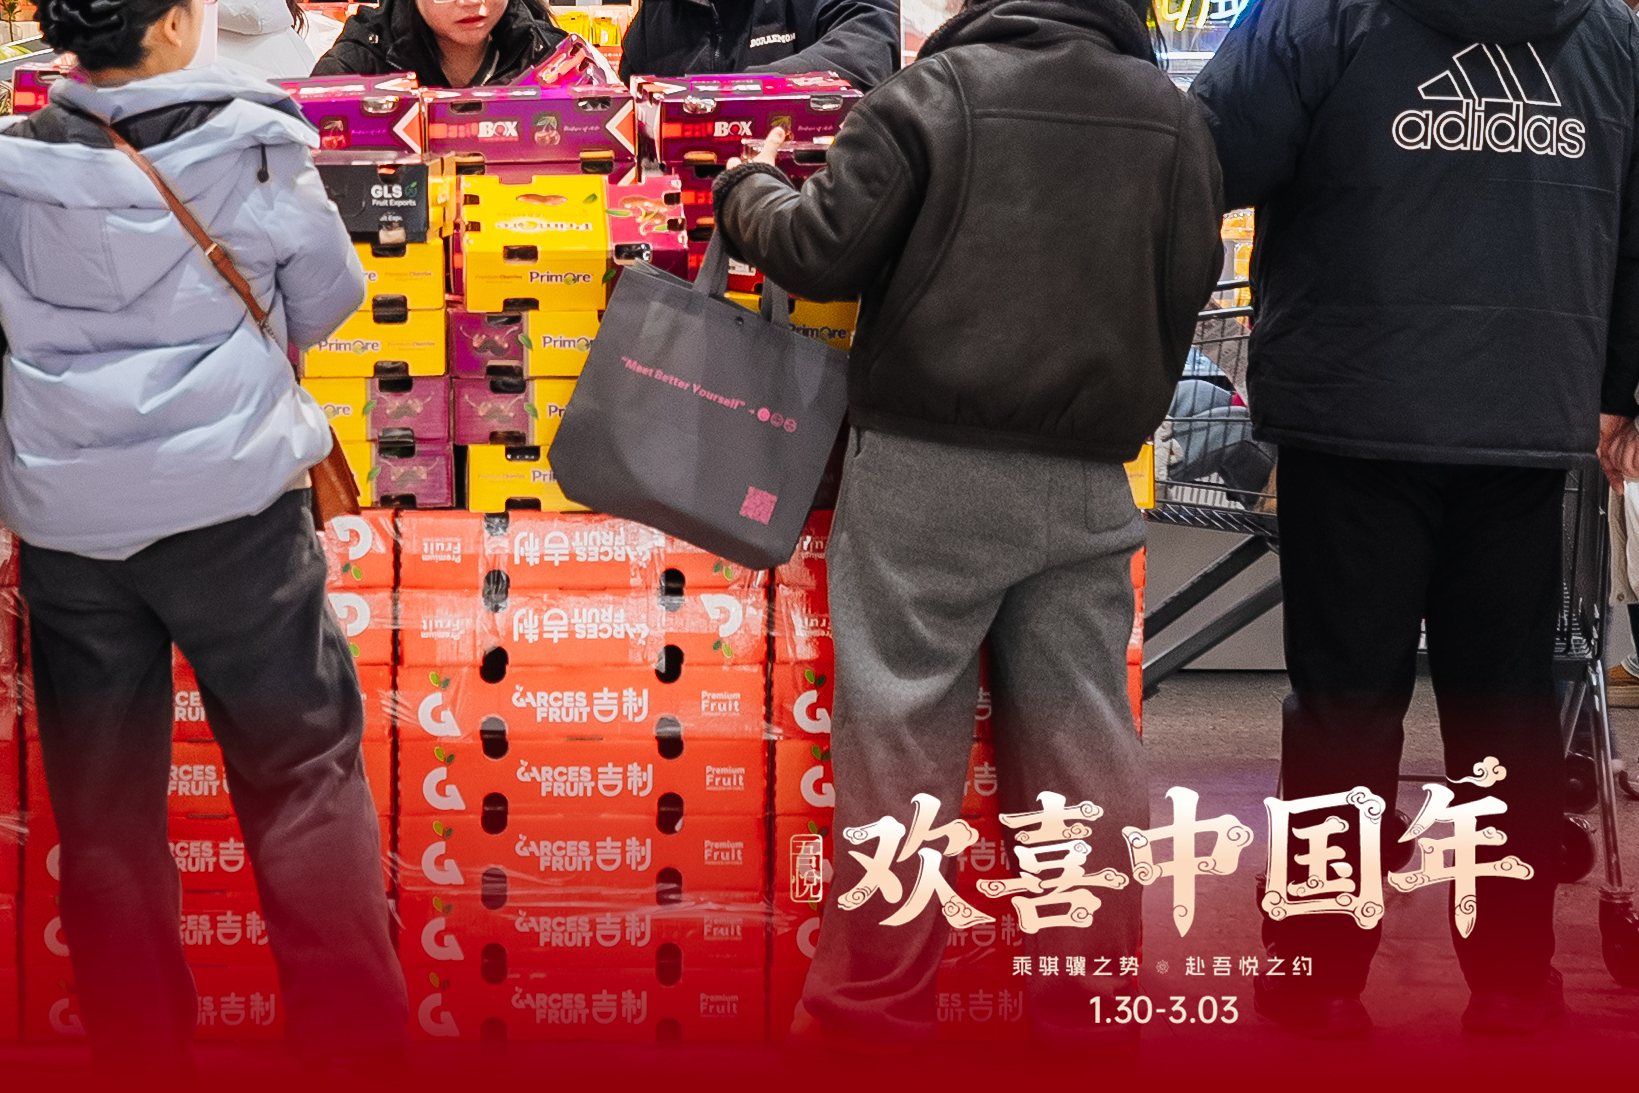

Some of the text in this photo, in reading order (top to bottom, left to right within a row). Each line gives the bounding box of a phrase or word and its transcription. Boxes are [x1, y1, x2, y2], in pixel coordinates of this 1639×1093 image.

[713, 121, 753, 137] BOX
[1391, 98, 1586, 159] adidas
[371, 184, 403, 198] GLS
[371, 199, 417, 208] Fruit Exports
[654, 368, 691, 391] Better
[512, 686, 588, 708] GARCES
[701, 690, 741, 701] Premium
[536, 706, 591, 723] FRUIT
[701, 700, 741, 713] Fruit
[167, 765, 217, 782] RCES
[516, 760, 592, 783] GARCES
[706, 765, 746, 776] Premium
[541, 780, 595, 797] FRUIT
[706, 774, 745, 788] Fruit
[514, 834, 591, 857] GARCES
[704, 839, 744, 850] Premium
[539, 854, 594, 872] FRUIT
[704, 849, 744, 863] Fruit
[175, 857, 217, 873] RUIT
[514, 909, 591, 932] GARCES
[704, 914, 743, 925] Premium
[539, 929, 594, 948] FRUIT
[704, 923, 743, 938] Fruit
